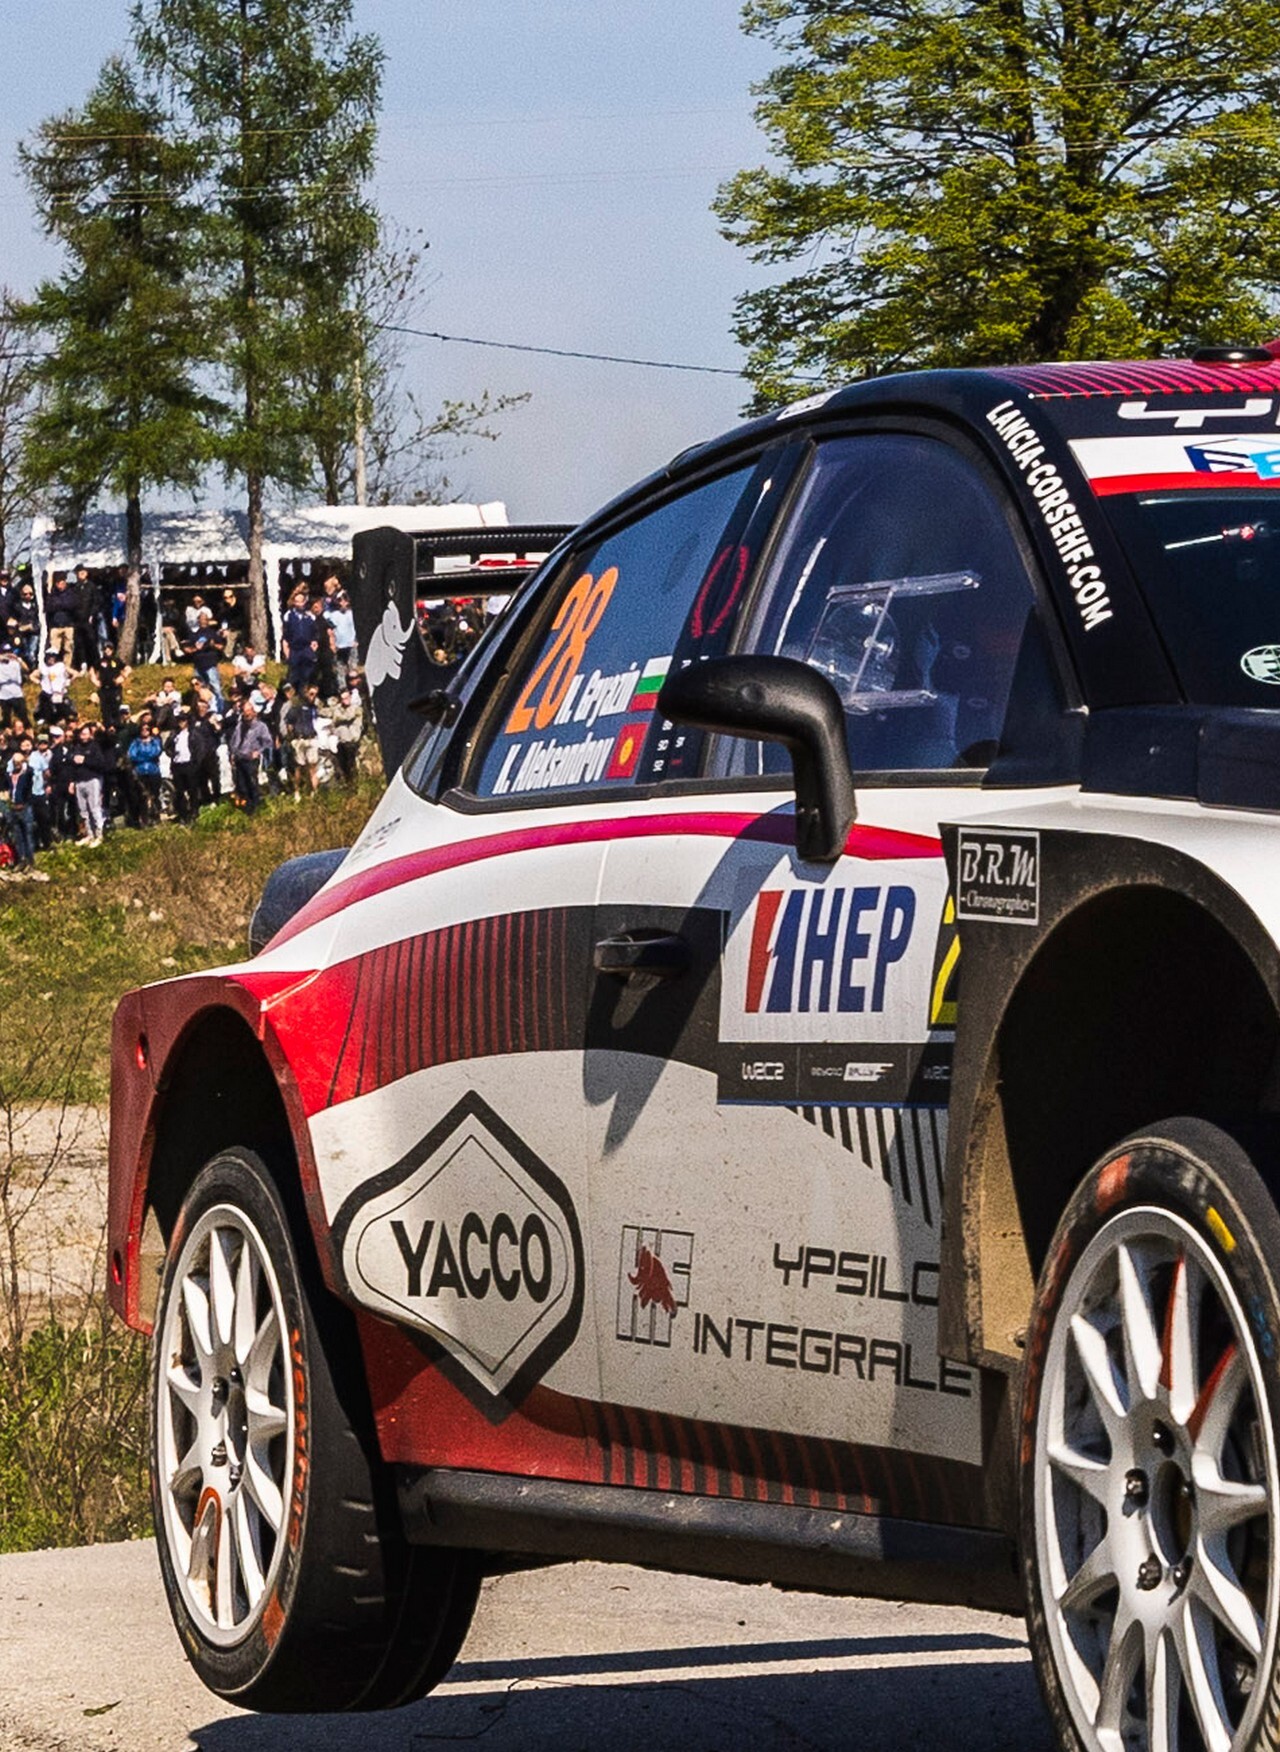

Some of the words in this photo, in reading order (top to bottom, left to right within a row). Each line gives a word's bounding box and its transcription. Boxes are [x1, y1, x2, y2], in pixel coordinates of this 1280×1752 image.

[985, 400, 1114, 632] LANCIA-CORSEHF.COM
[504, 565, 619, 735] 28
[389, 1210, 553, 1304] YACCO
[772, 1242, 941, 1307] YPSILO
[692, 1312, 973, 1398] INTEGRALE
